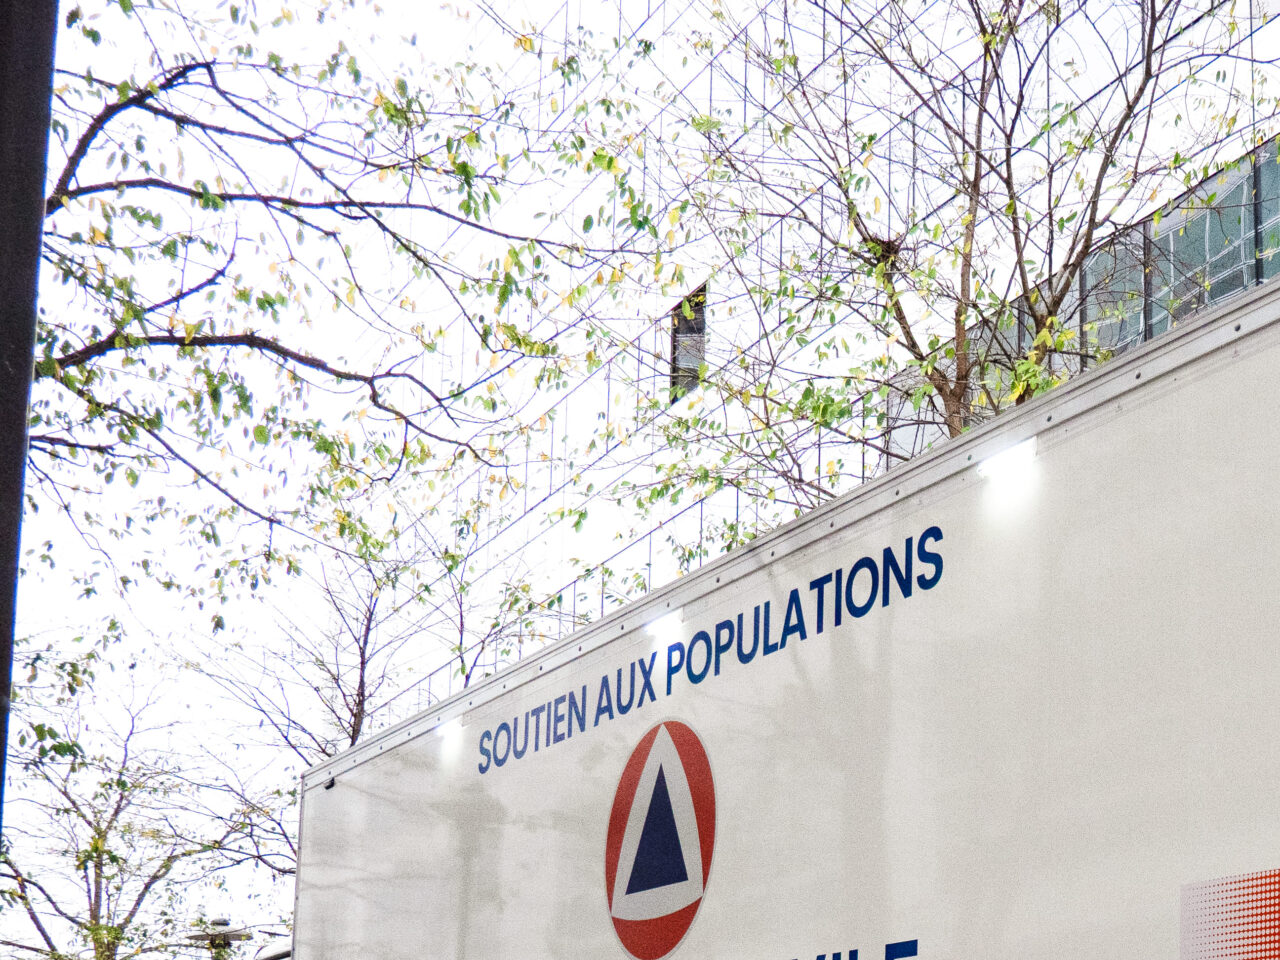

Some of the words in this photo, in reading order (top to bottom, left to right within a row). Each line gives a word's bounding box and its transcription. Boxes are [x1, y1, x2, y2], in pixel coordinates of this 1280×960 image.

[477, 684, 587, 775] SOUTIEN
[593, 651, 658, 728] AUX
[665, 525, 945, 697] POPULATIONS
